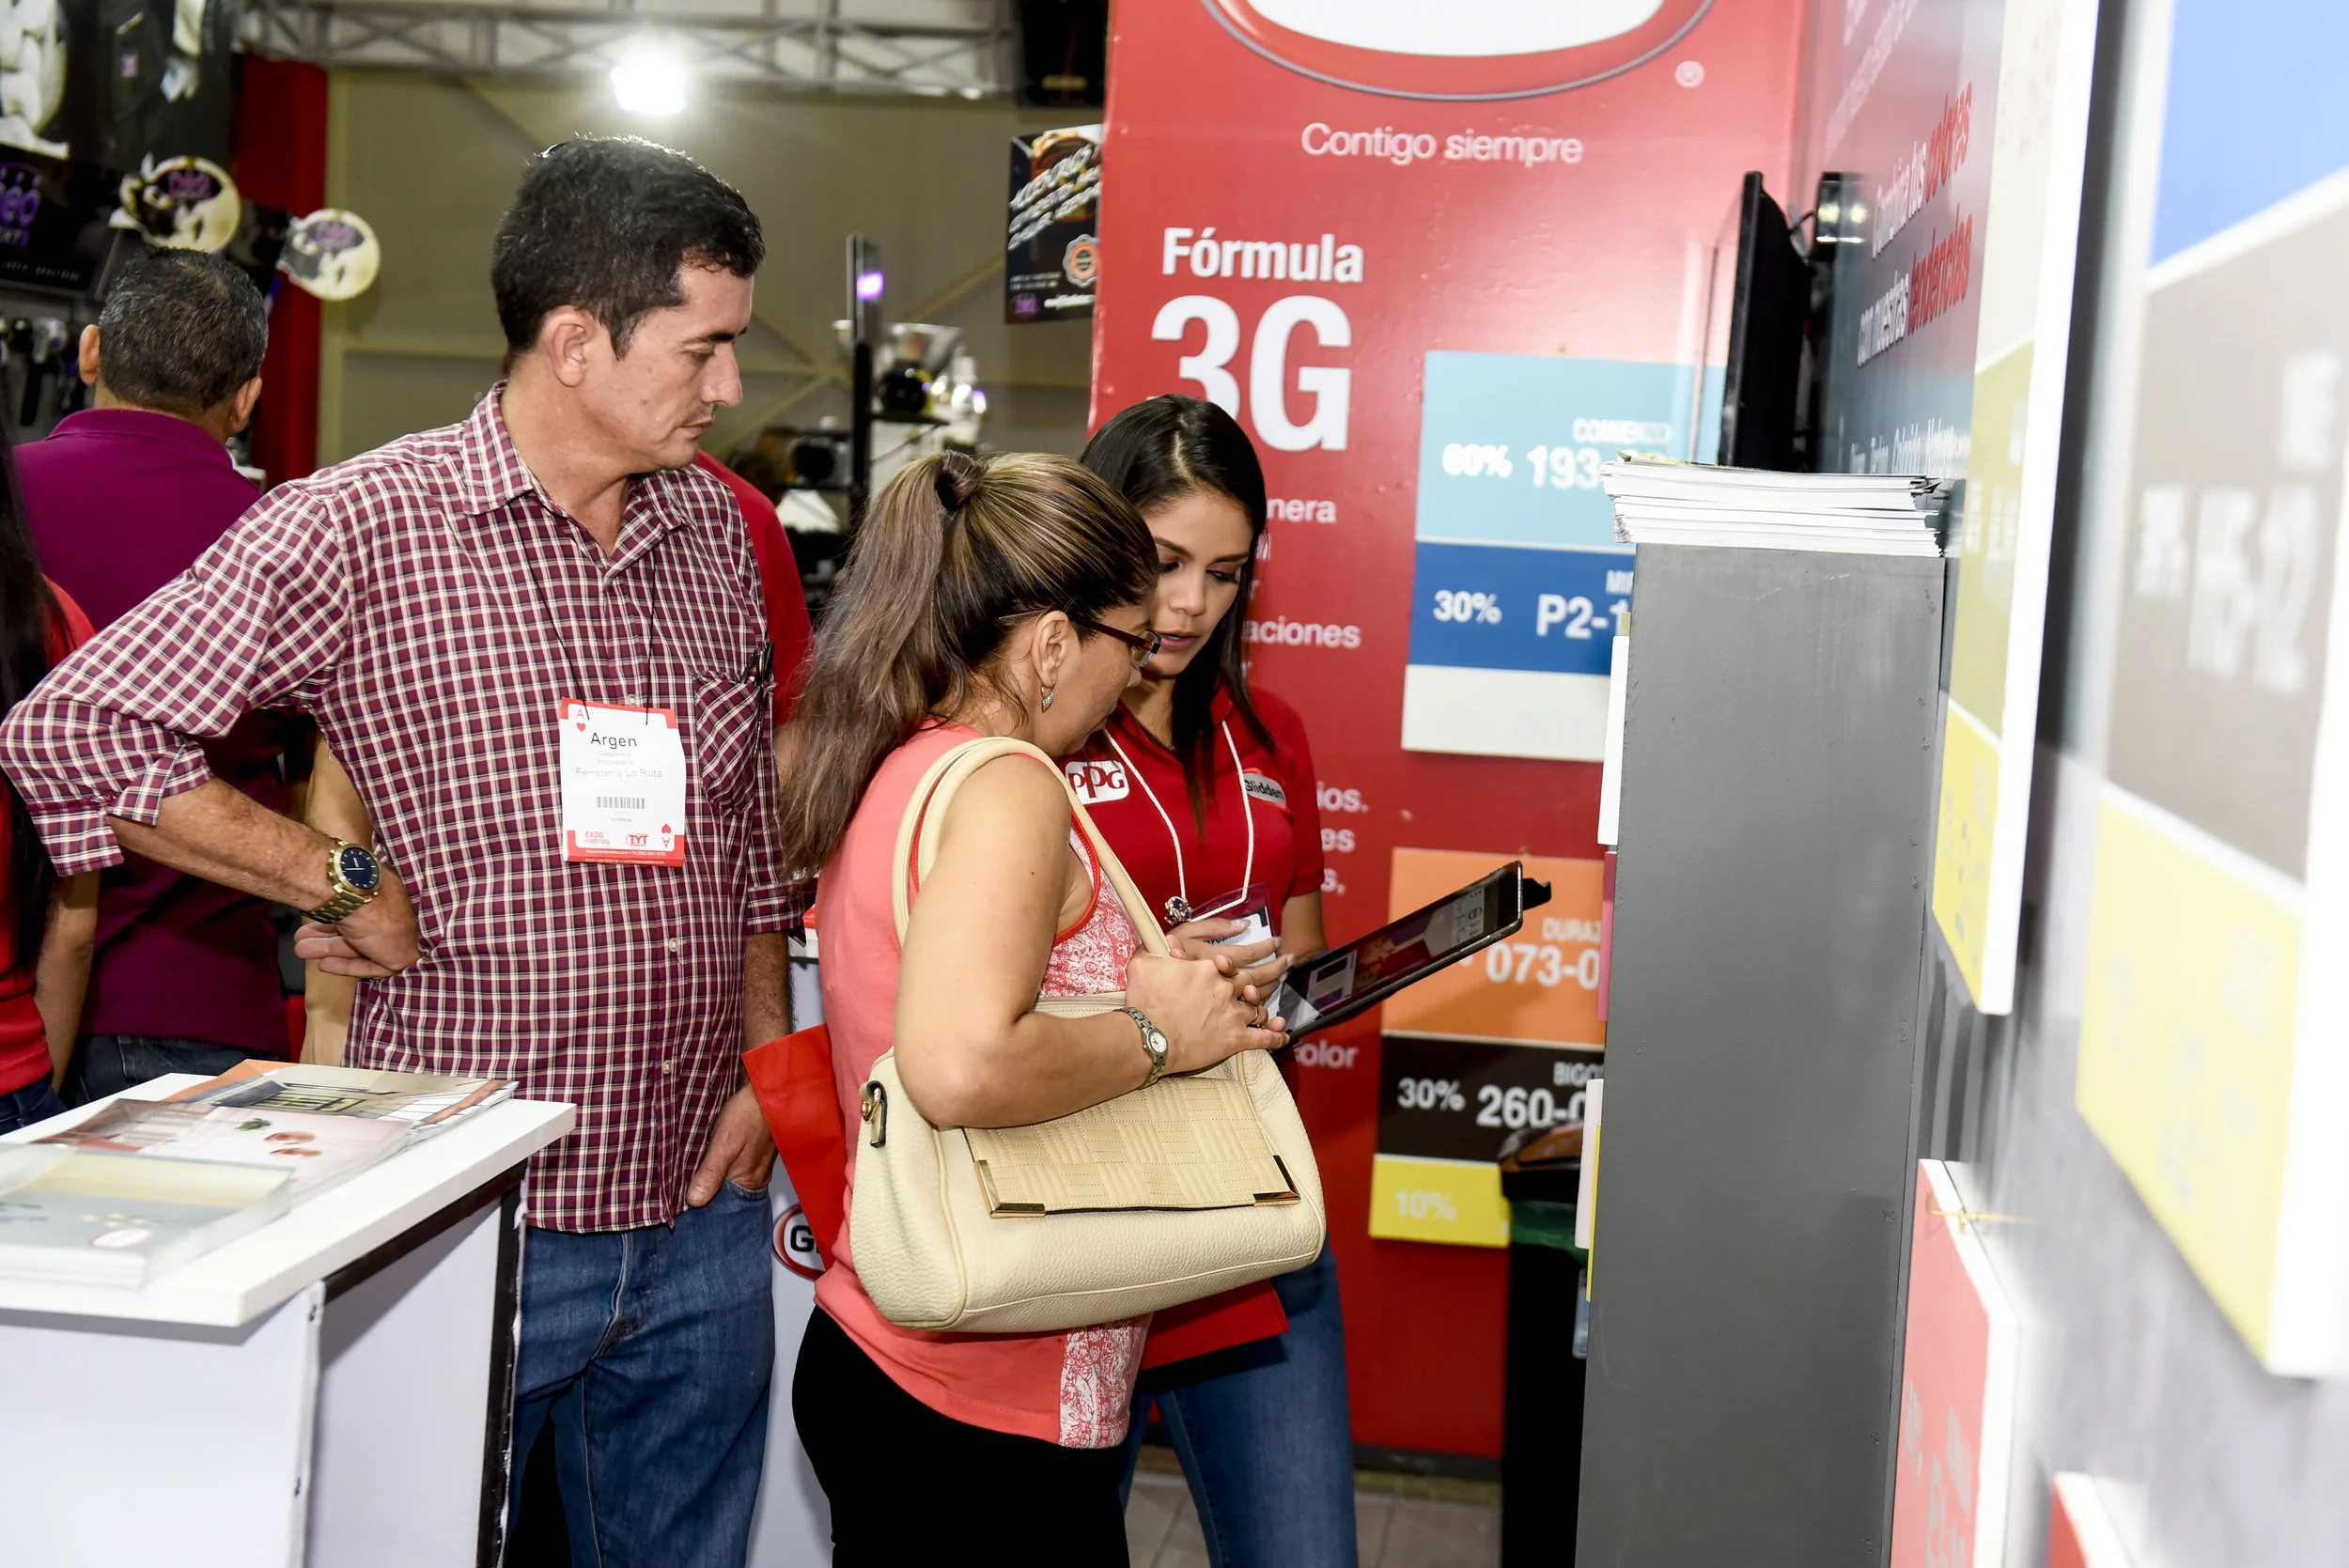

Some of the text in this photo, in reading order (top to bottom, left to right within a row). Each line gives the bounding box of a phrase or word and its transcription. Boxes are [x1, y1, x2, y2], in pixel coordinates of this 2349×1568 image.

[1302, 122, 1584, 168] Contigo siempre
[1925, 81, 1972, 204] colores
[1163, 227, 1364, 284] Fórmula
[1907, 202, 1972, 336] tendencias
[1147, 295, 1352, 453] 3G
[1526, 444, 1601, 491] 193
[1266, 498, 1337, 524] nera
[1433, 589, 1502, 625] 30%
[1241, 615, 1361, 649] aciones
[590, 732, 637, 750] Argen
[1316, 780, 1369, 814] ios.
[1320, 828, 1355, 853] es
[1486, 940, 1600, 990] 073-0
[1552, 1061, 1603, 1087] BIGO
[1397, 1077, 1466, 1111] 30%
[1394, 1189, 1457, 1221] 10%
